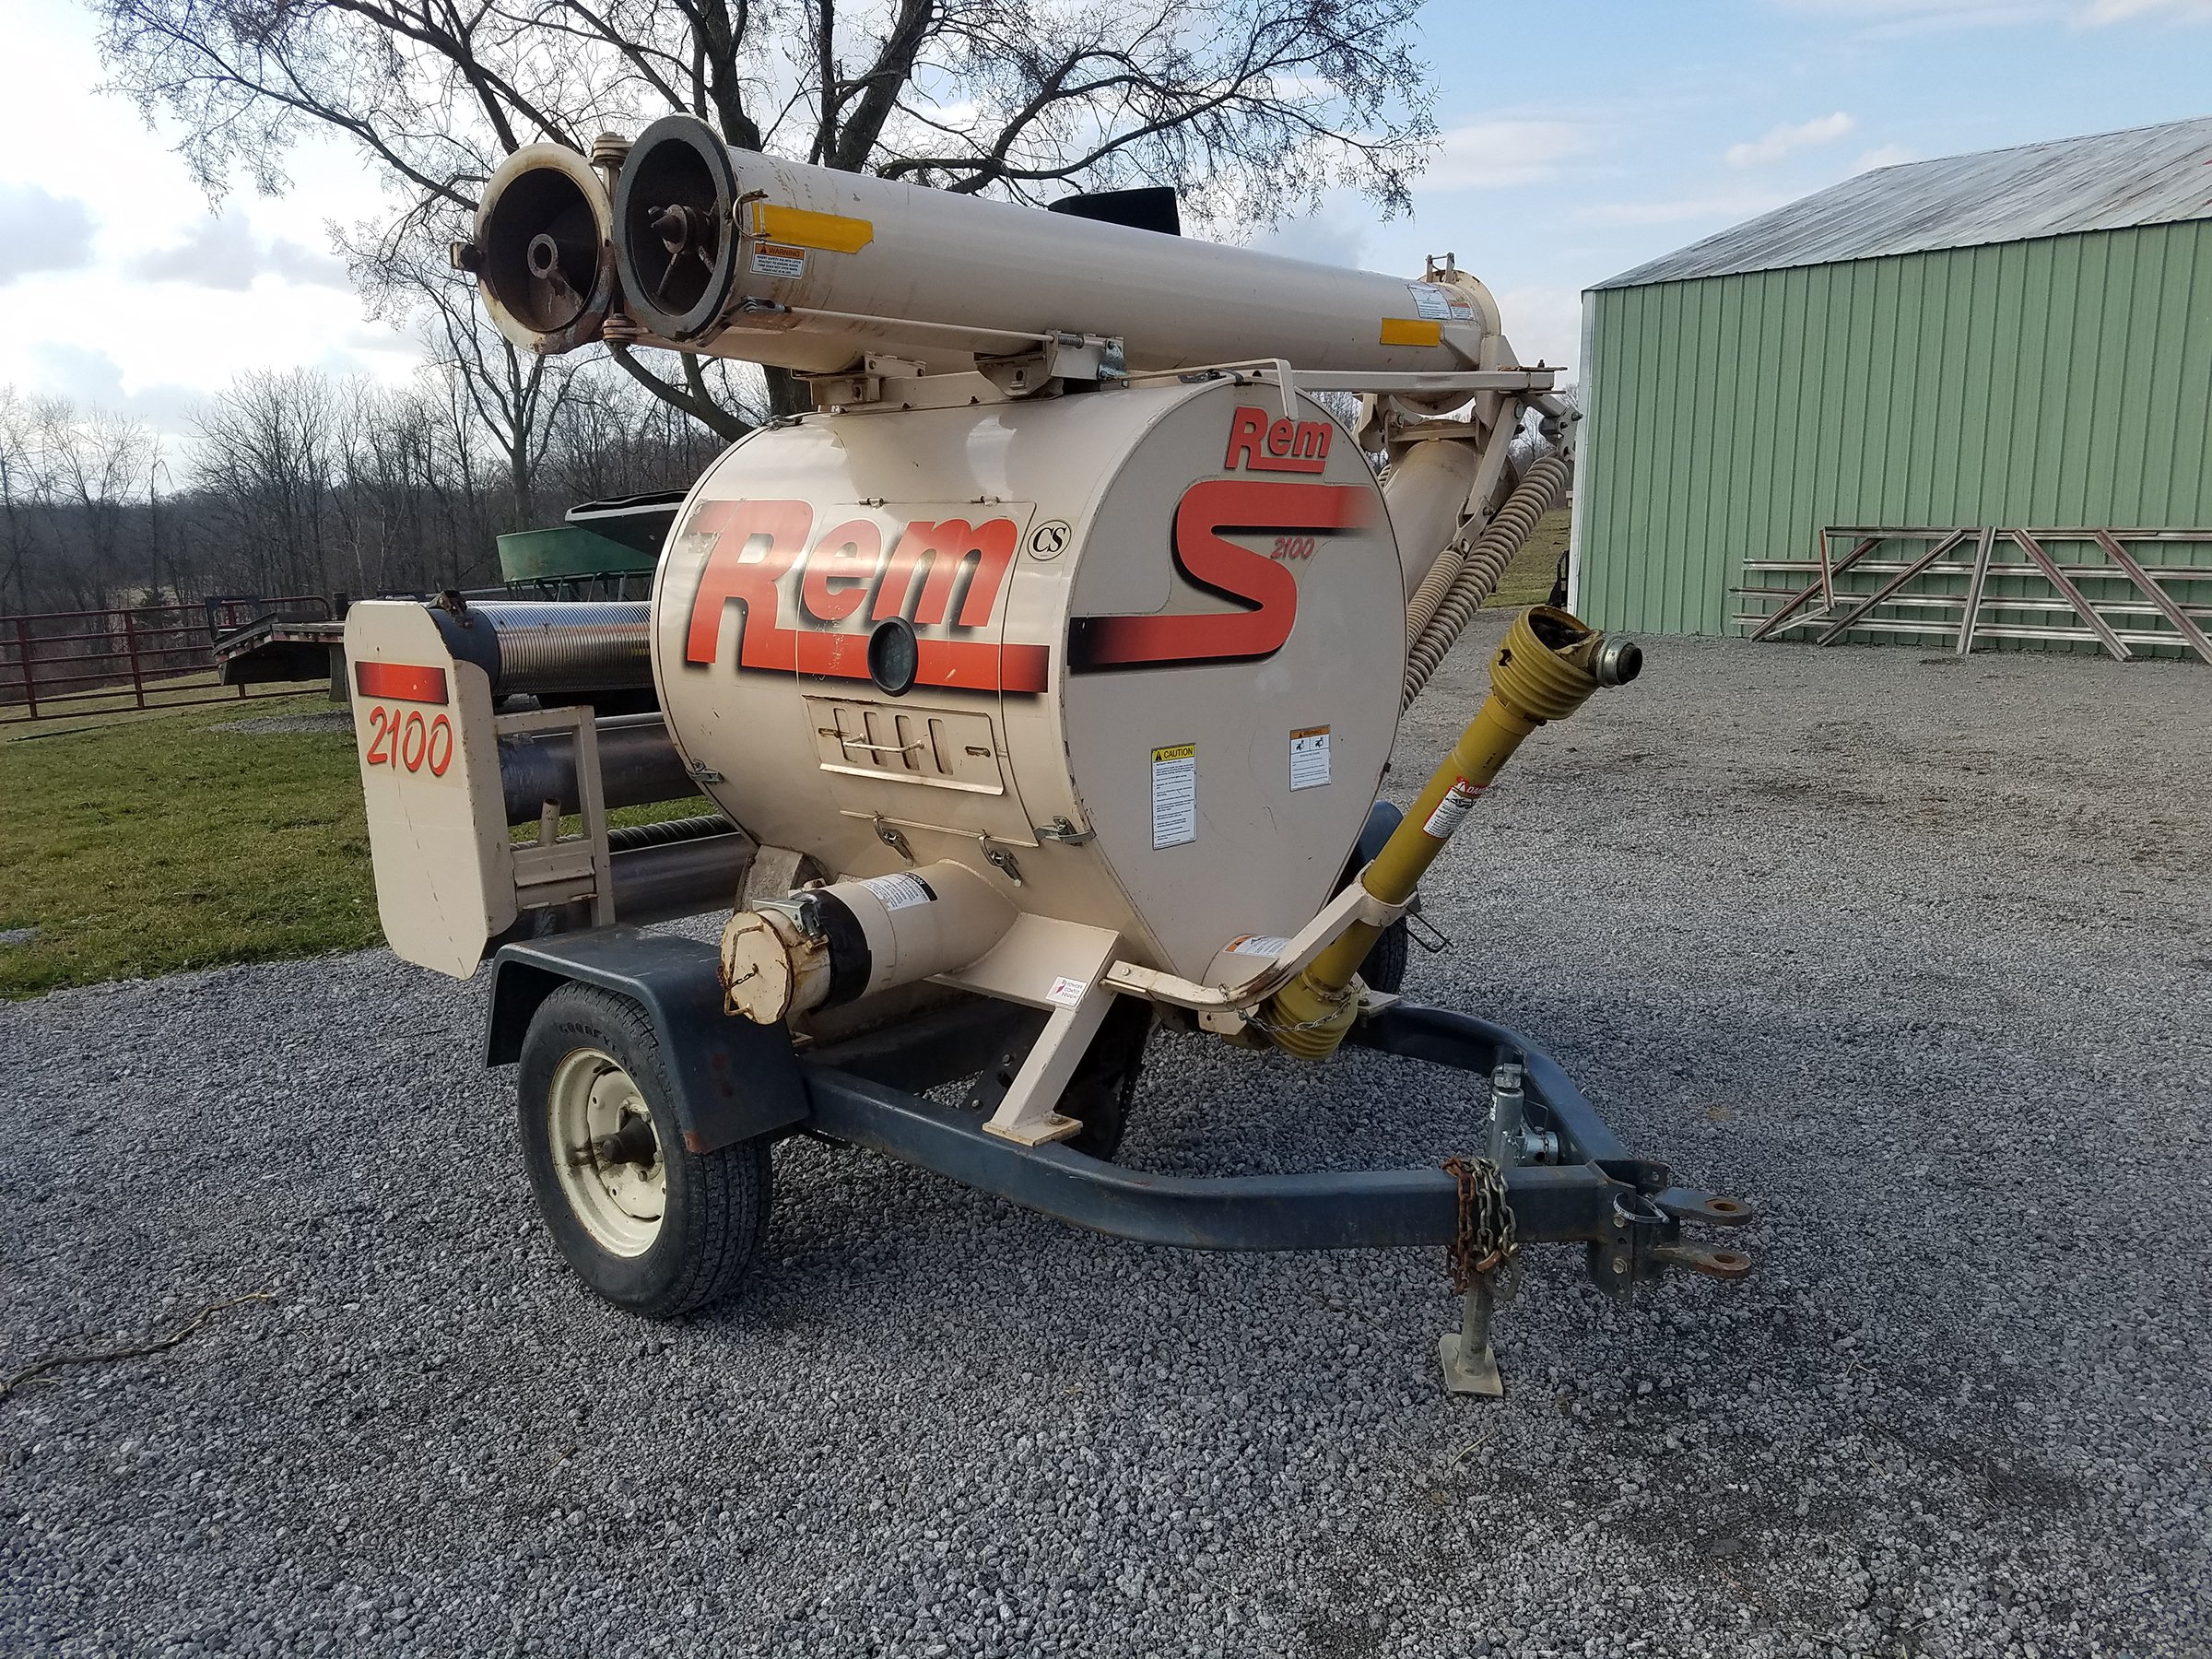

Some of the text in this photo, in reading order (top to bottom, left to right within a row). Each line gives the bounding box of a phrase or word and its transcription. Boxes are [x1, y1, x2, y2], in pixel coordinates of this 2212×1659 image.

[769, 247, 800, 257] WARNING
[1226, 406, 1334, 473] Rem
[1032, 526, 1067, 553] CS
[1270, 536, 1315, 559] 2100
[682, 499, 1025, 677] Rem
[367, 705, 453, 777] 2100
[1163, 747, 1193, 759] CAUTION
